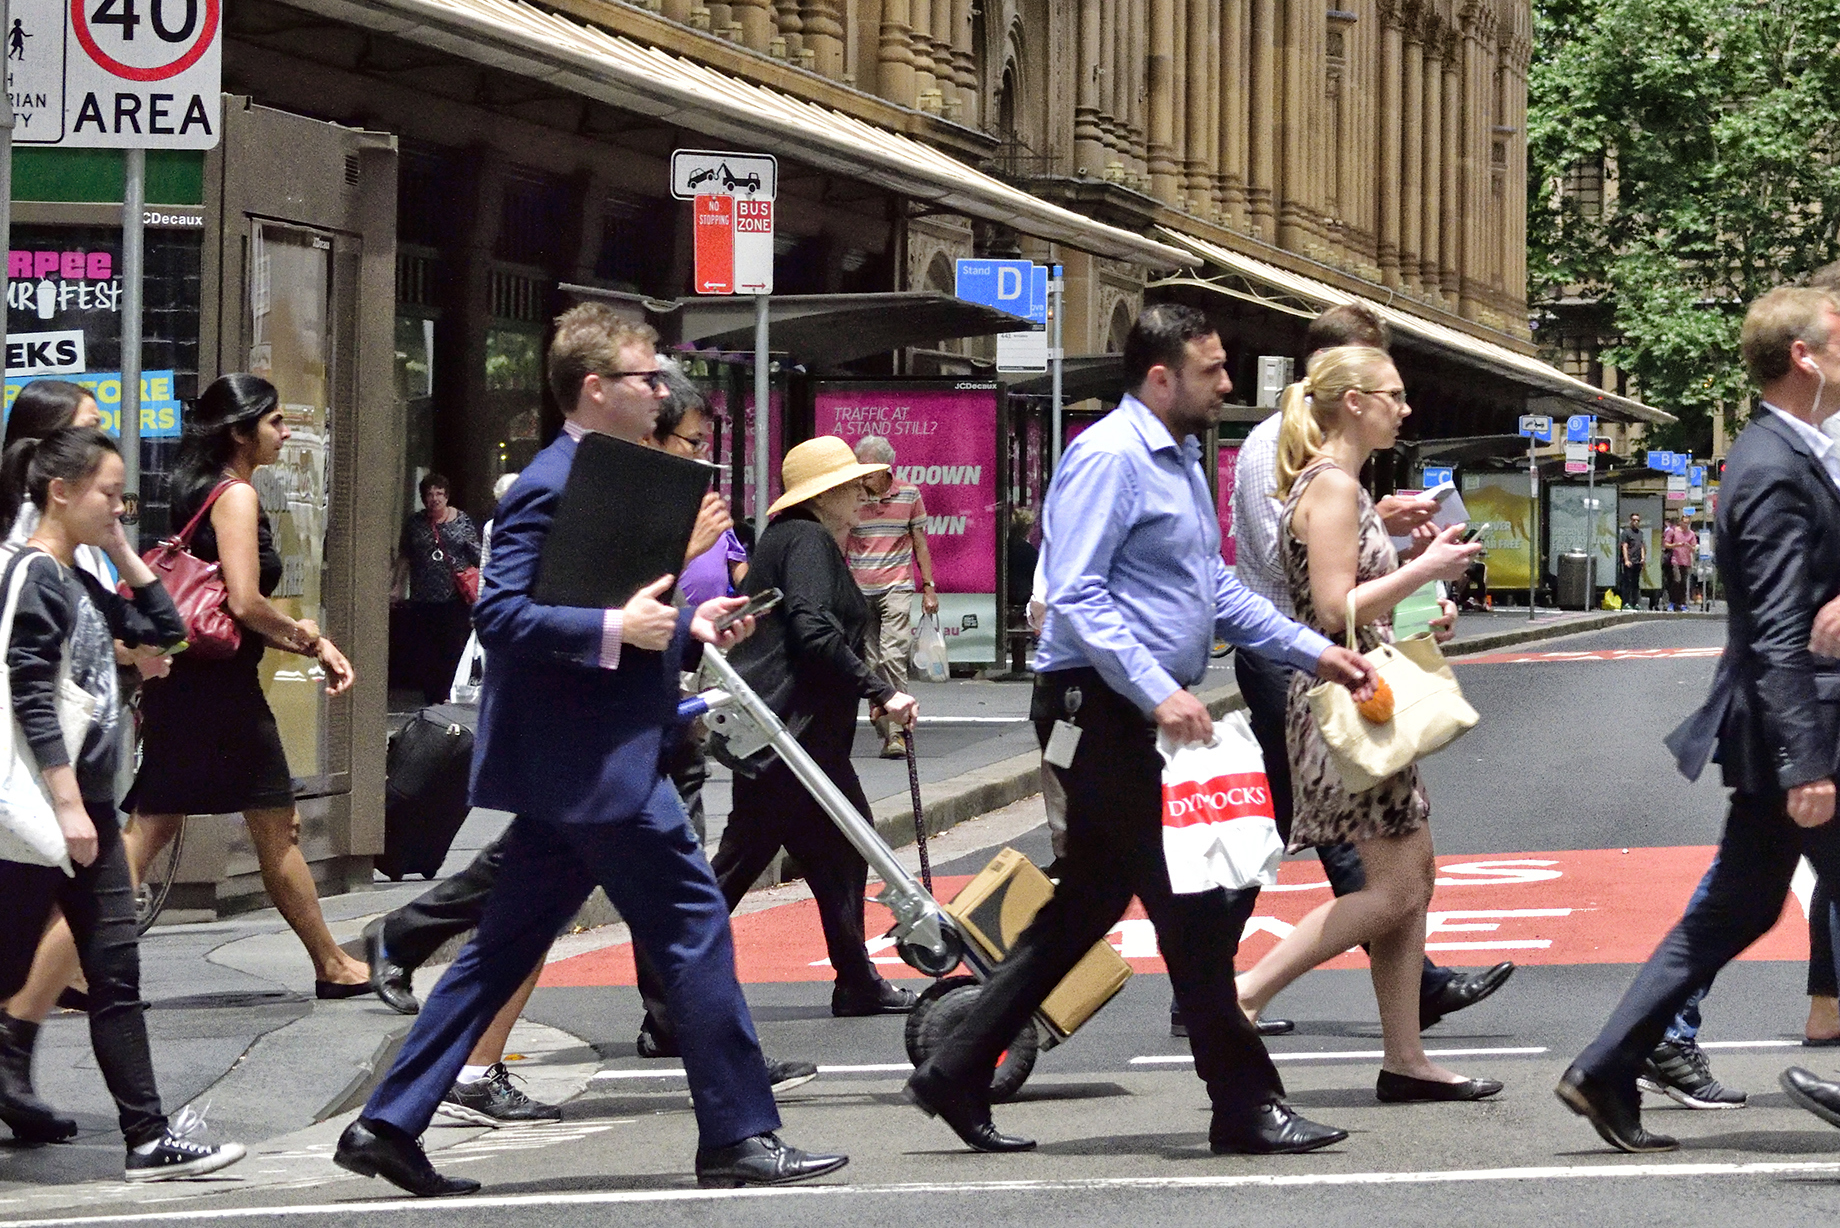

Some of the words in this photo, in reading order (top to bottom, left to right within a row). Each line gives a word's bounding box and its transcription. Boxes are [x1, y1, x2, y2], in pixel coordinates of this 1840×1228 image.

[73, 91, 213, 135] AREA
[708, 201, 720, 211] NO
[740, 202, 768, 216] BUS
[699, 214, 730, 226] STOPPING
[738, 218, 770, 231] ZONE
[963, 265, 990, 275] Stand
[997, 266, 1022, 300] D
[834, 407, 889, 421] TRAFFIC
[891, 407, 910, 421] AT
[832, 422, 843, 435] A
[847, 422, 891, 435] STAND
[895, 422, 938, 435] STILL?
[890, 465, 982, 485] KDOWN
[923, 516, 966, 535] WN
